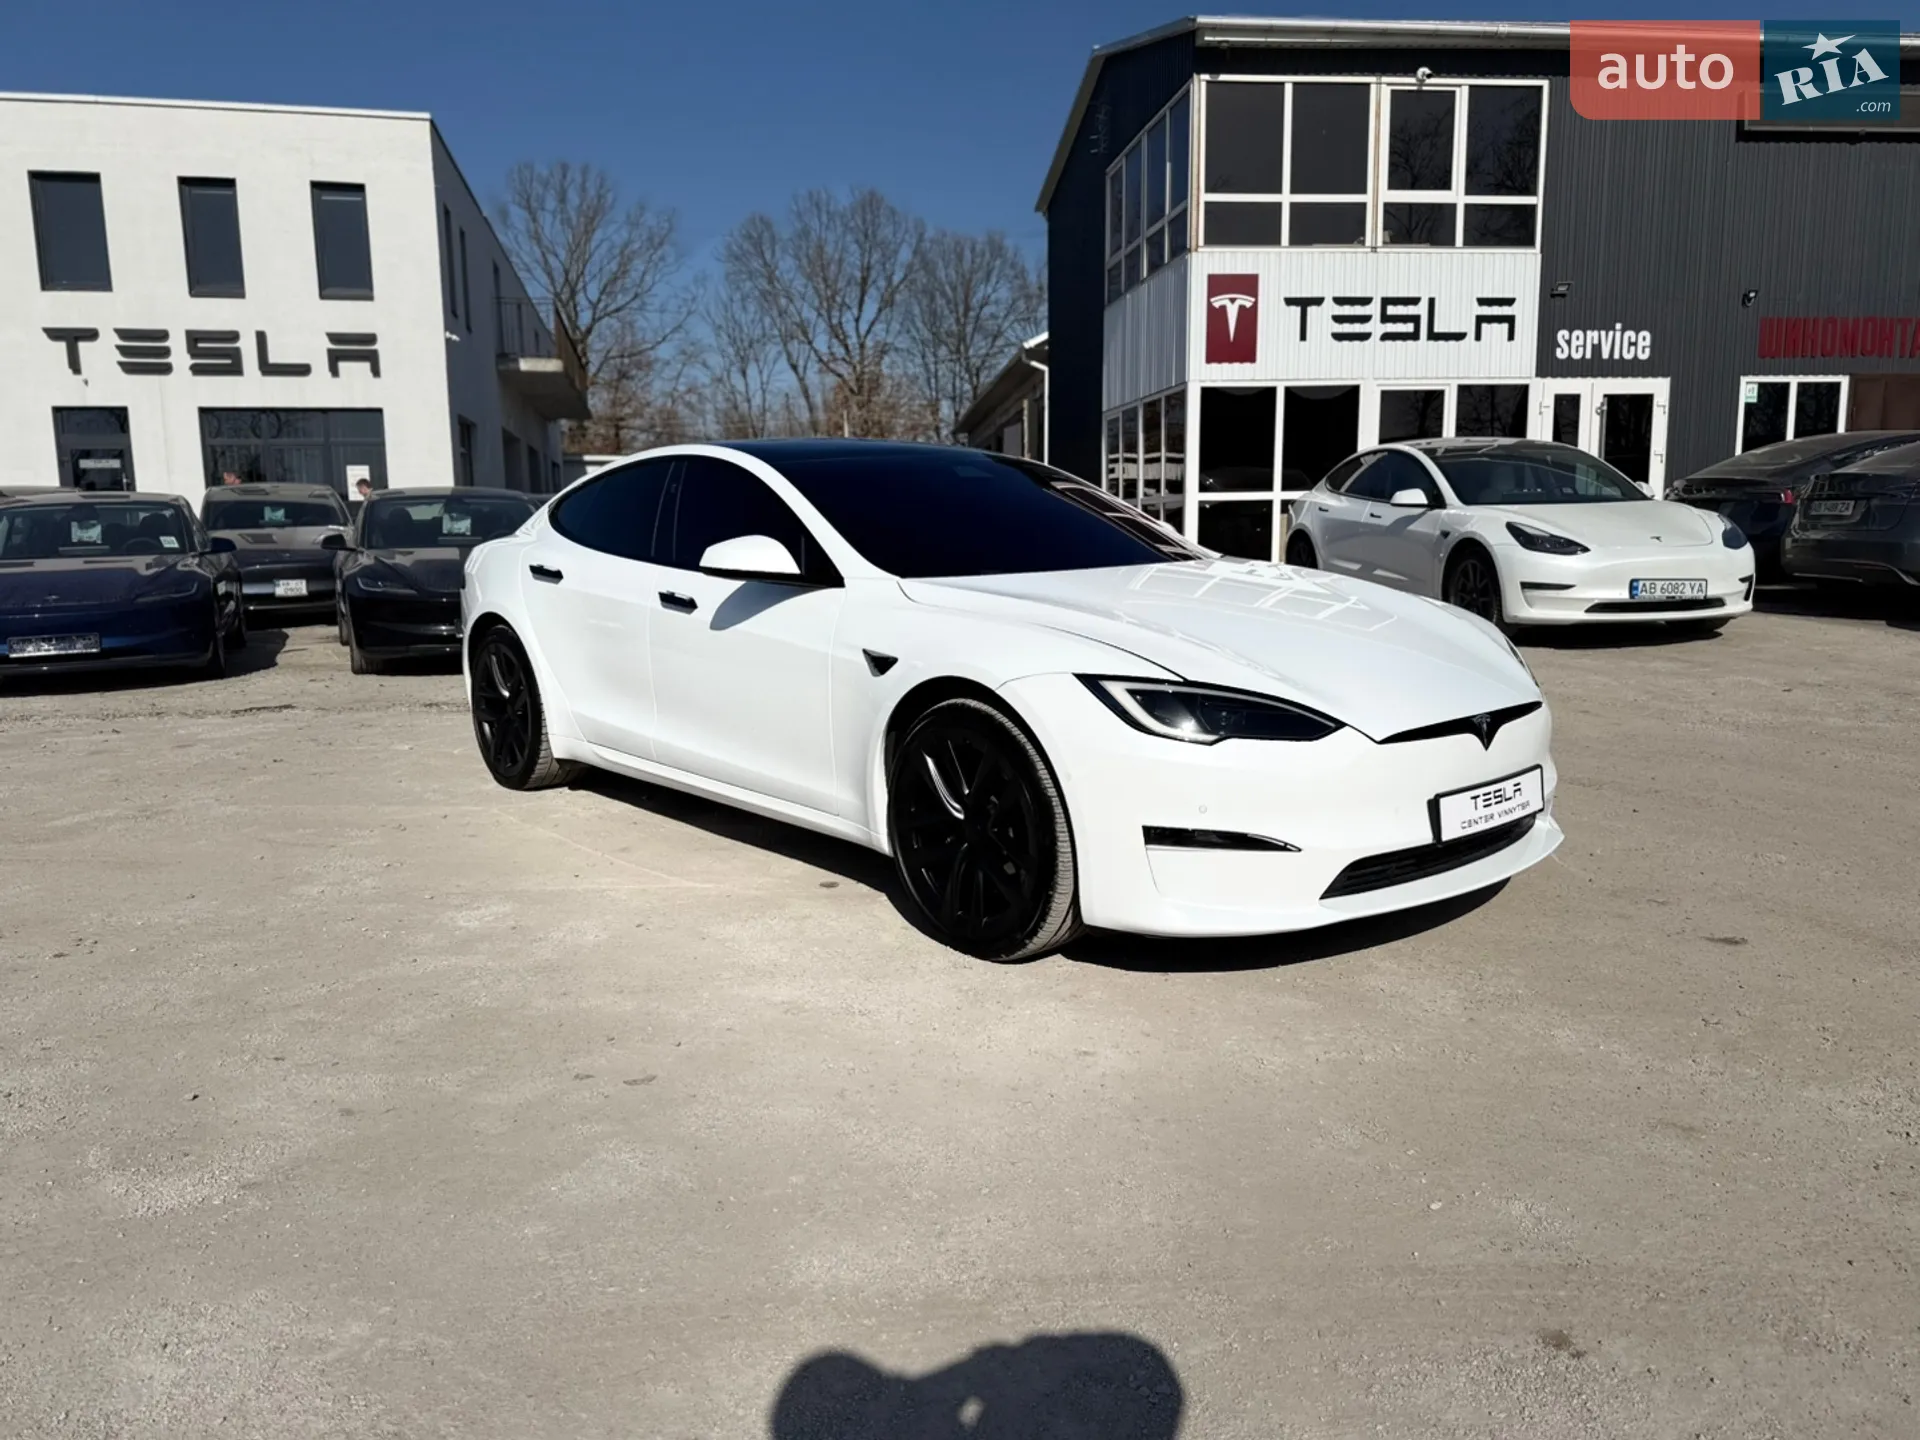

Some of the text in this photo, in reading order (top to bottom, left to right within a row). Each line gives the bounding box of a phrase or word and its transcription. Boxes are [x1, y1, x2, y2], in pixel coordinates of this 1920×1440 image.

[1283, 297, 1516, 342] TESLA
[41, 327, 381, 379] TESLA
[1555, 323, 1651, 360] service
[1640, 582, 1704, 594] AB 6082 YA
[1470, 782, 1523, 811] TESLA
[1461, 813, 1494, 829] CENTER
